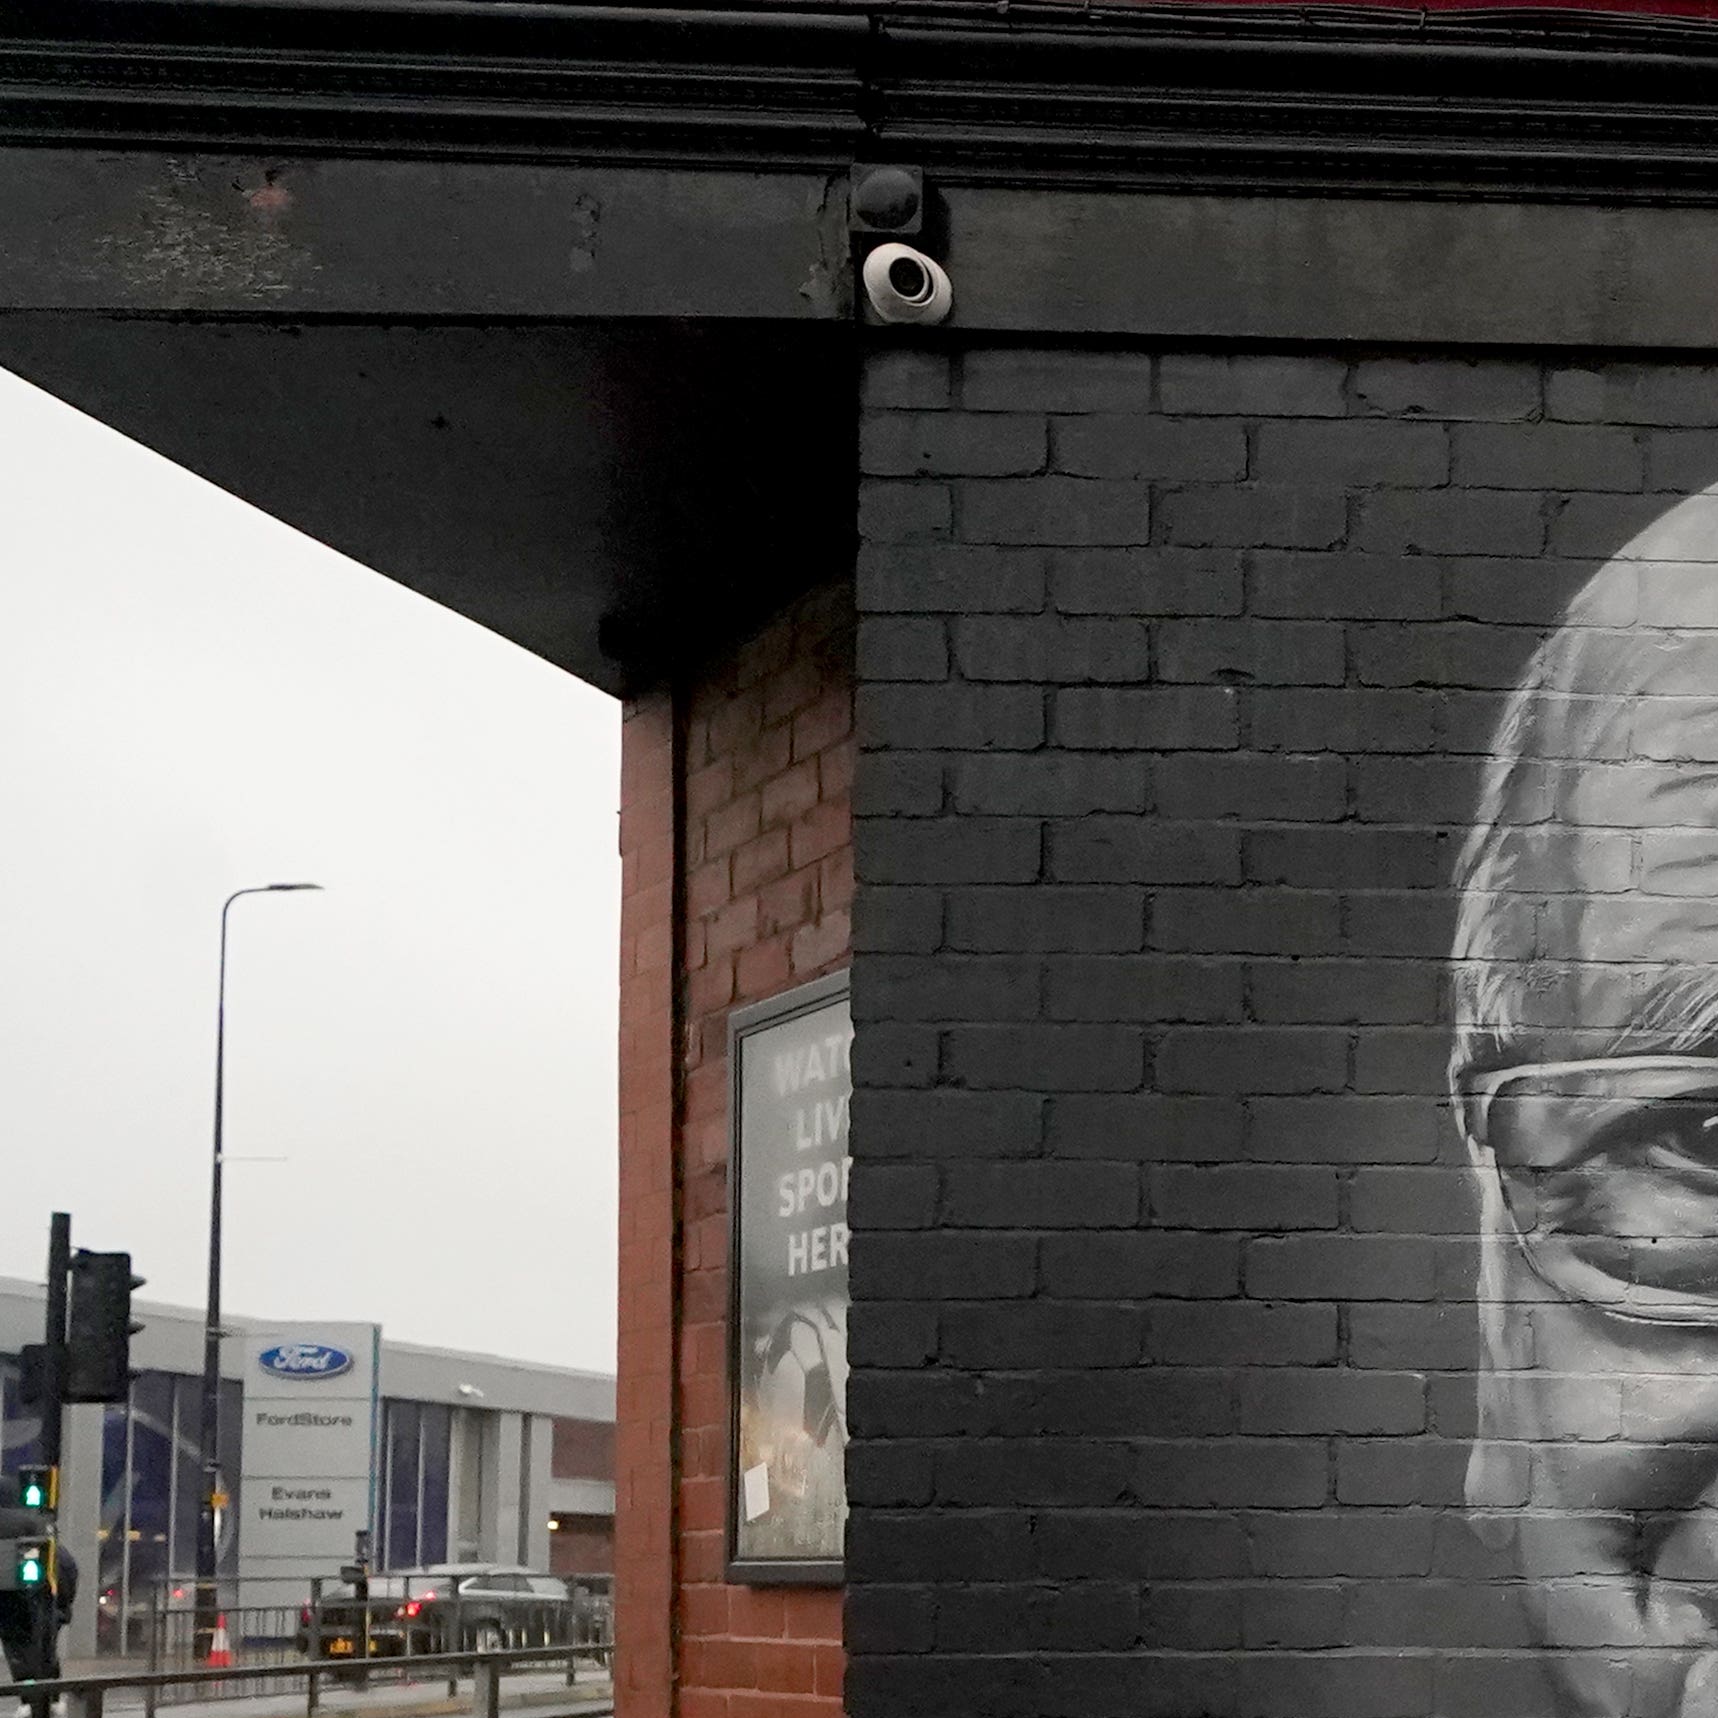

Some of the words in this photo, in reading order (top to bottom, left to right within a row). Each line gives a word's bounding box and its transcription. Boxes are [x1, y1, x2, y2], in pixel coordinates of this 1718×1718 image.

[273, 1344, 333, 1370] Ford
[256, 1412, 352, 1427] FordStore
[271, 1486, 331, 1501] Evans
[259, 1507, 344, 1521] Halshaw
